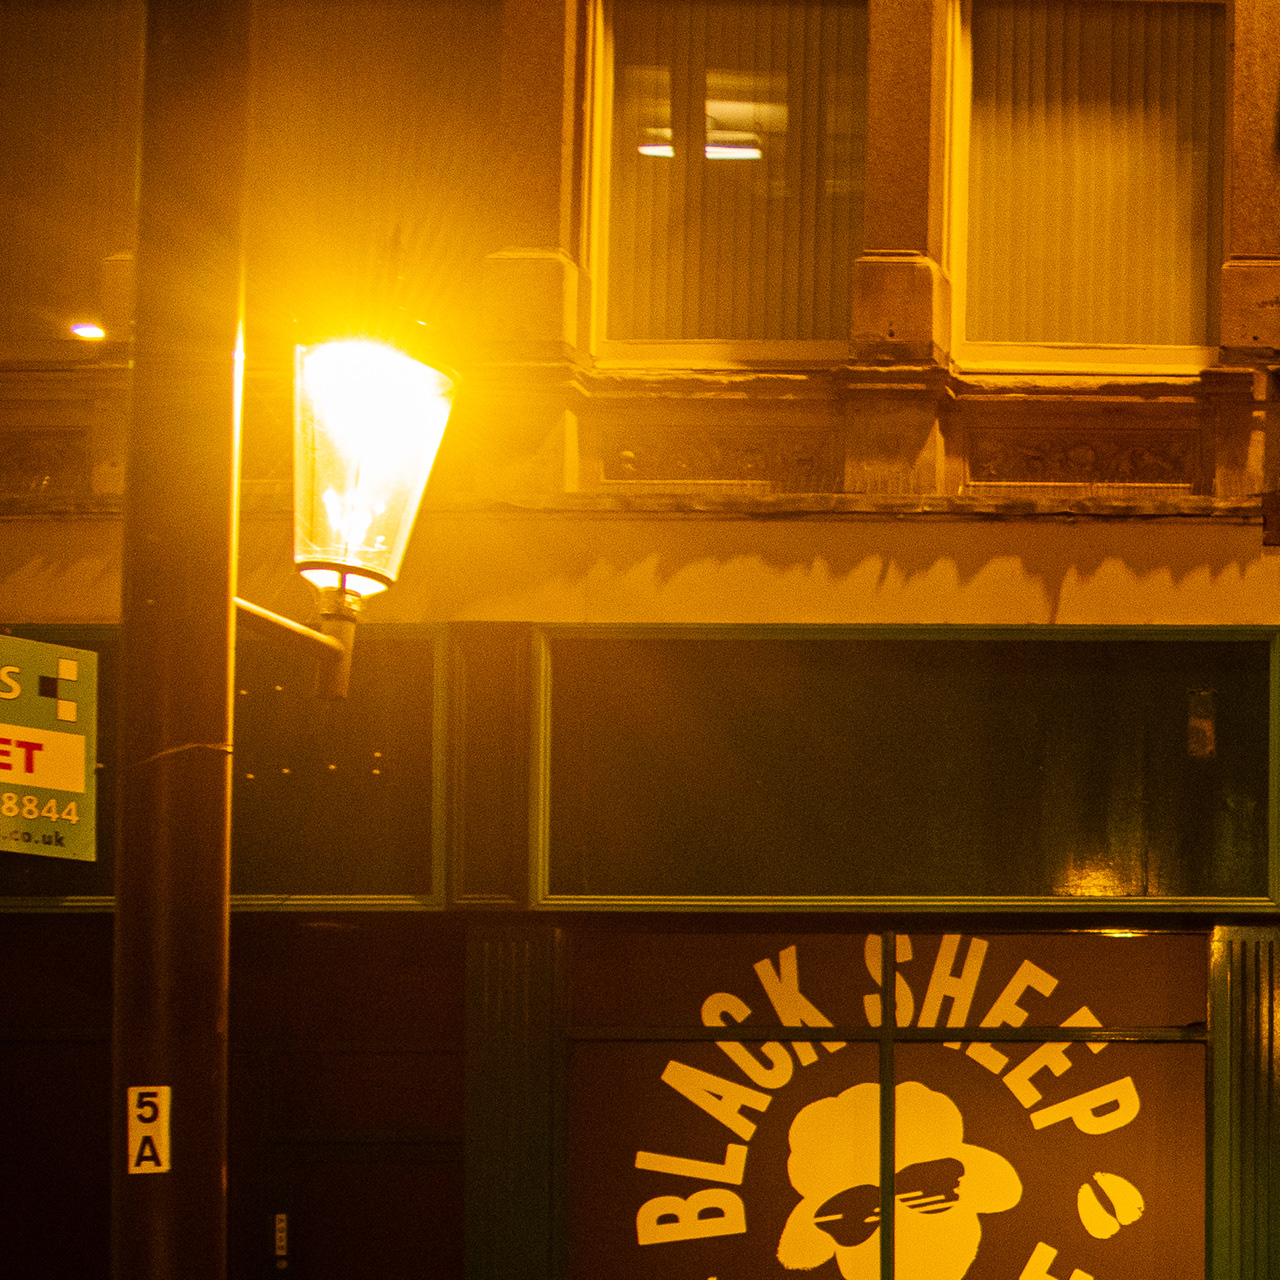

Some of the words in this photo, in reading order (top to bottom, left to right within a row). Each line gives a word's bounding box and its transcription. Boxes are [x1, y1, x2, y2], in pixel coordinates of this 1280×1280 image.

[635, 944, 847, 1246] BLACK
[863, 933, 1141, 1131] SHEEP
[137, 1092, 159, 1123] 5
[134, 1136, 161, 1167] A
